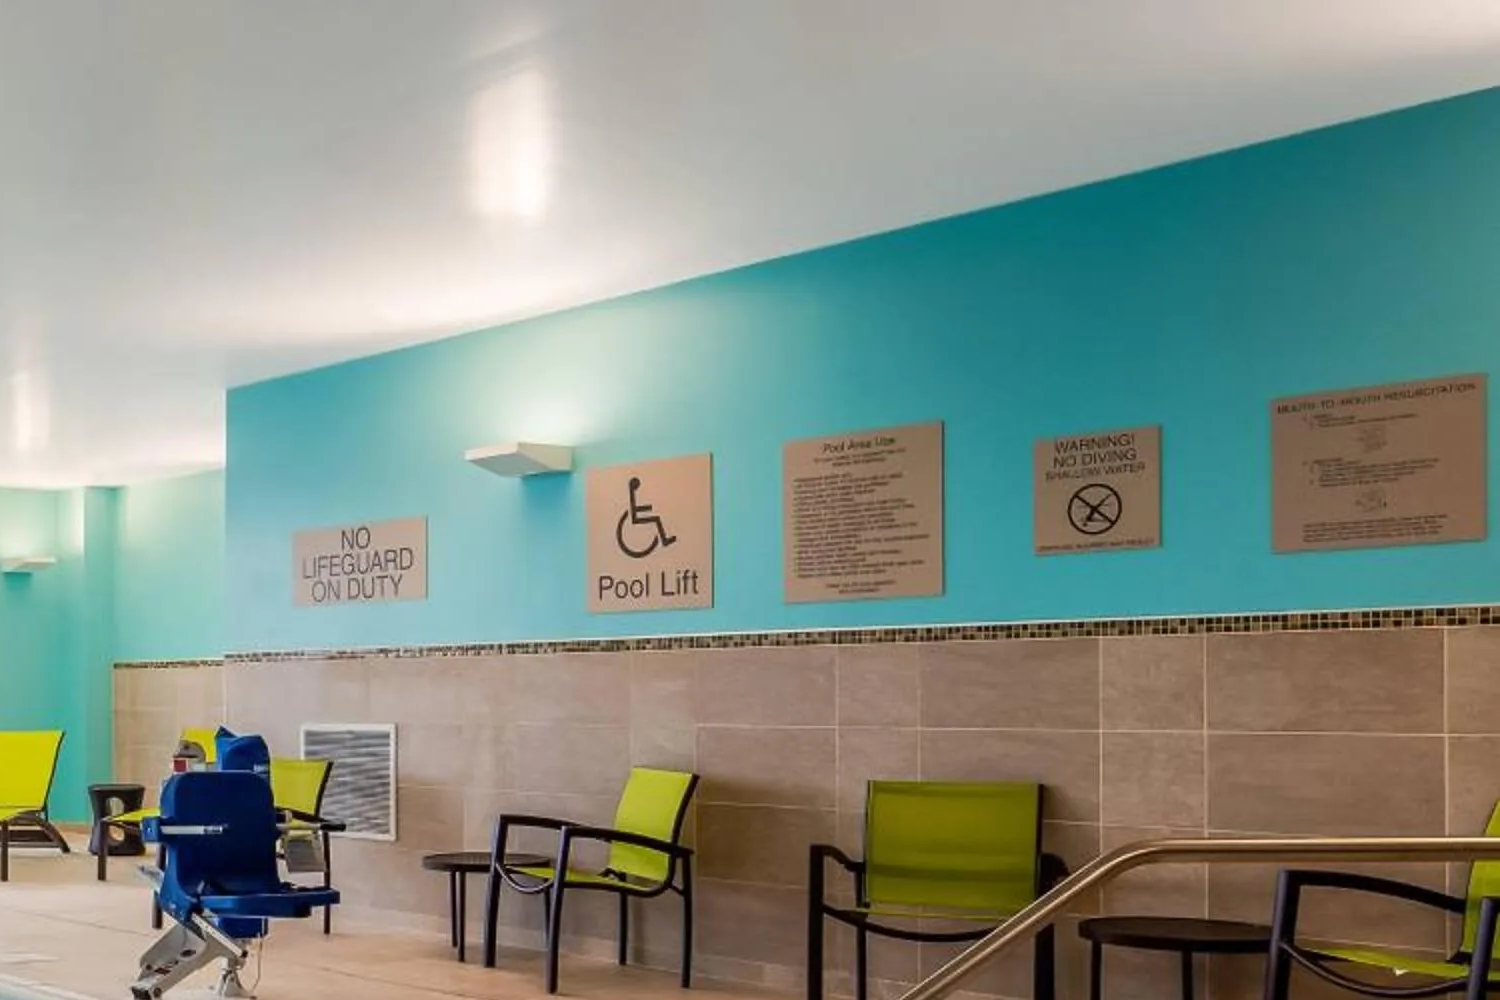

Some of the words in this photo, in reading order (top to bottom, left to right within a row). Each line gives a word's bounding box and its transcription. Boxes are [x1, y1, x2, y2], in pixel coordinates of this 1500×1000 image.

[823, 441, 845, 453] Pool
[848, 438, 872, 449] Area
[875, 435, 896, 445] Use
[1054, 433, 1135, 454] WARNING!
[1053, 455, 1077, 468] NO
[1081, 447, 1137, 466] DIVING
[1045, 466, 1101, 482] SHALLOW
[1103, 461, 1146, 475] WATER
[341, 526, 371, 550] NO
[302, 547, 414, 579] LIFEGUARD
[311, 580, 341, 603] ON
[347, 574, 403, 601] DUTY
[598, 572, 649, 601] Pool
[661, 570, 699, 597] Lift
